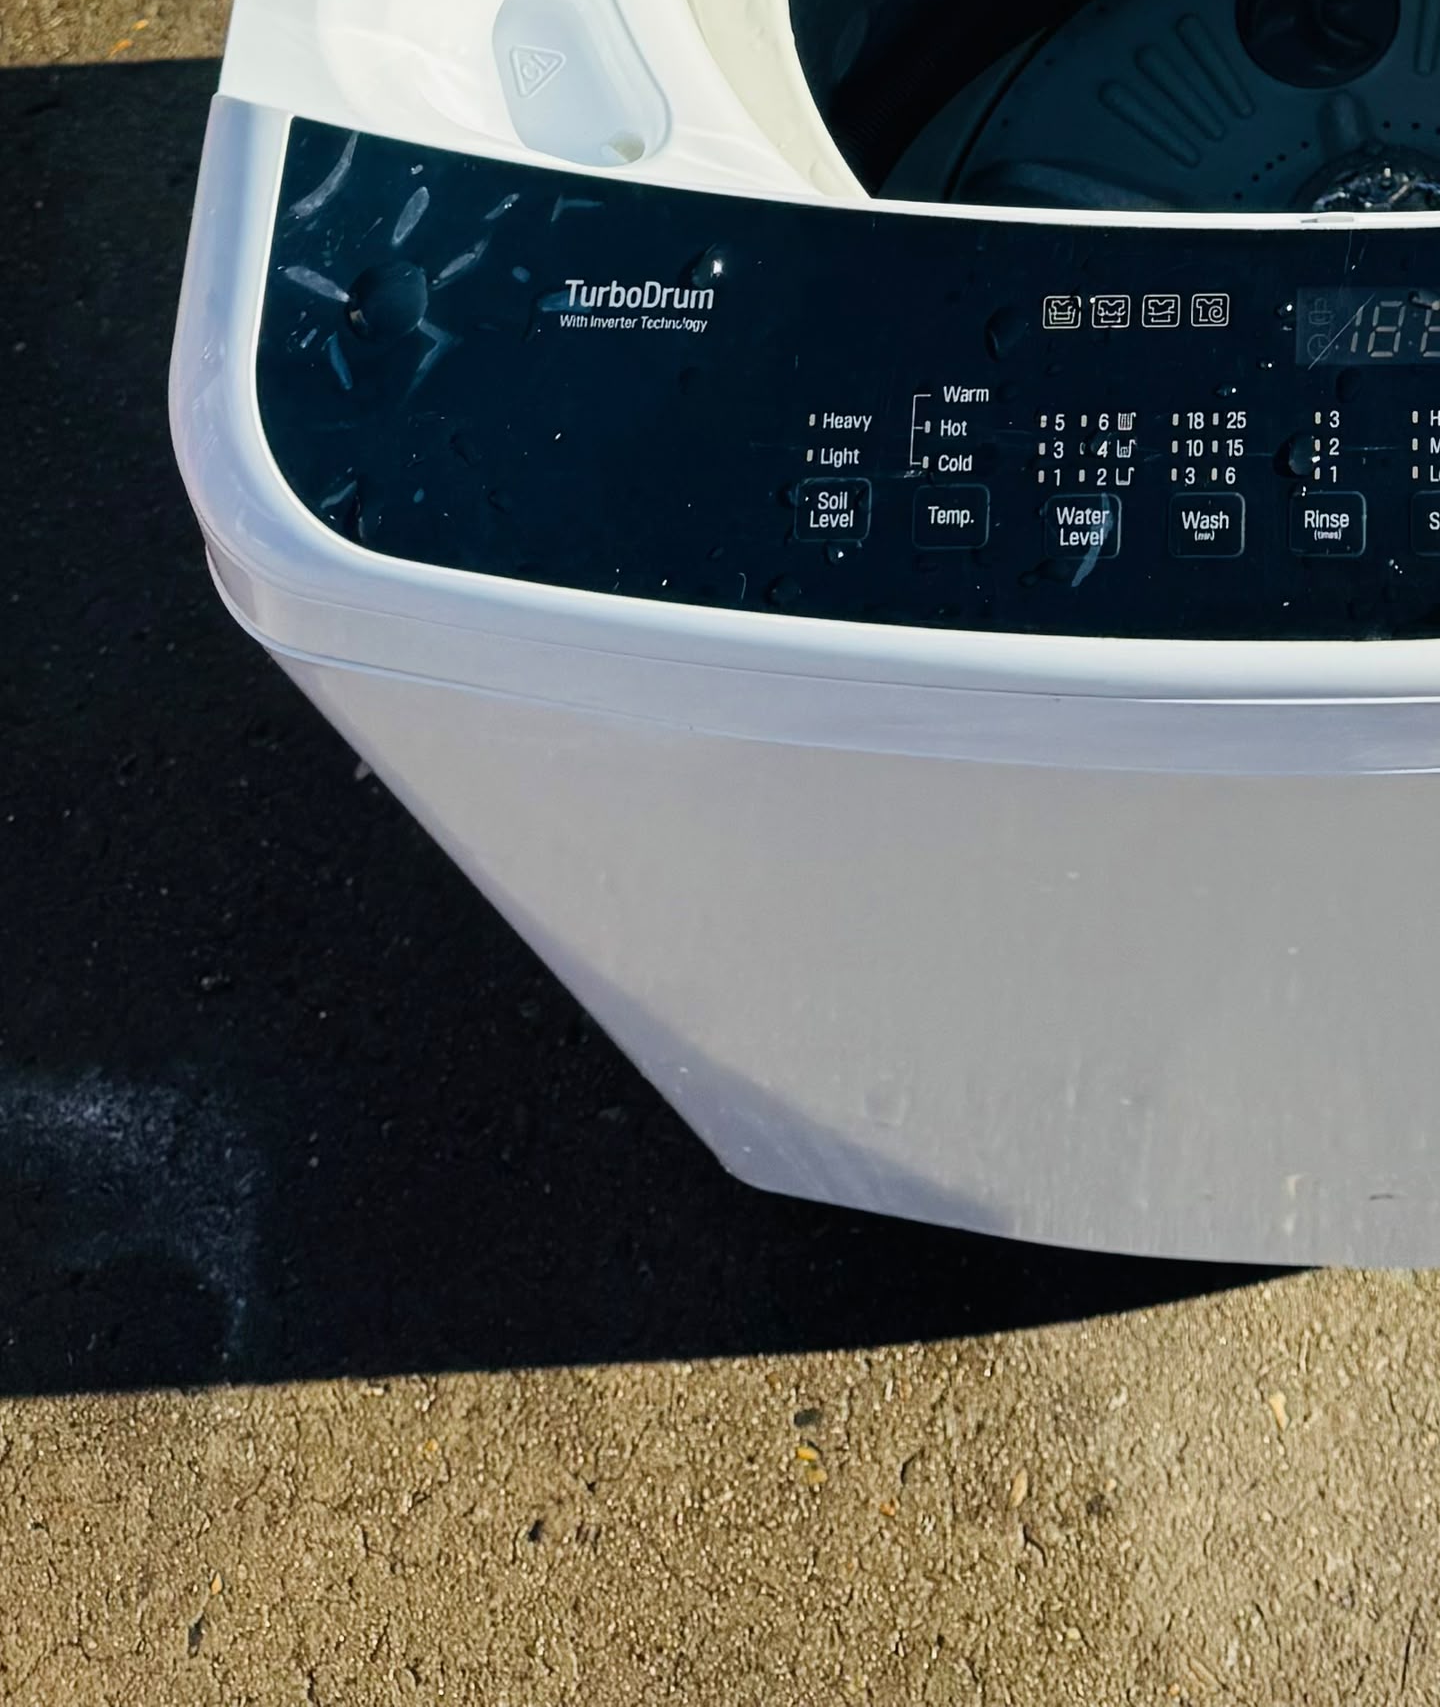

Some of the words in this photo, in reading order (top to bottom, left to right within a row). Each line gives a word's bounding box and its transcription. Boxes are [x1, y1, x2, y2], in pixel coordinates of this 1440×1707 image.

[564, 279, 715, 310] TurboDrum
[559, 314, 588, 328] With
[590, 315, 639, 329] Inverter
[943, 386, 990, 403] Warm
[822, 412, 872, 432] Heavy
[940, 419, 968, 437] Hot
[1054, 413, 1065, 431] 5
[1098, 413, 1110, 430] 6
[1186, 412, 1205, 429] 18
[1226, 411, 1247, 429] 25
[1328, 410, 1340, 428] 3
[1053, 441, 1064, 459] 3
[1096, 440, 1108, 457] 4
[1185, 439, 1204, 457] 10
[1226, 439, 1244, 456] 15
[1328, 438, 1340, 455] 2
[820, 447, 861, 468] Light
[937, 454, 973, 472] Cold
[1053, 468, 1062, 486] 1
[1096, 468, 1107, 485] 2
[1184, 467, 1196, 485] 3
[1225, 466, 1236, 485] 6
[1329, 466, 1339, 483] 1
[817, 491, 848, 510] Soil
[809, 509, 854, 528] Level
[927, 505, 975, 528] Temp.
[1056, 506, 1110, 525] Water
[1181, 510, 1230, 530] Wash
[1303, 510, 1350, 530] Rinse
[1059, 528, 1105, 546] Level
